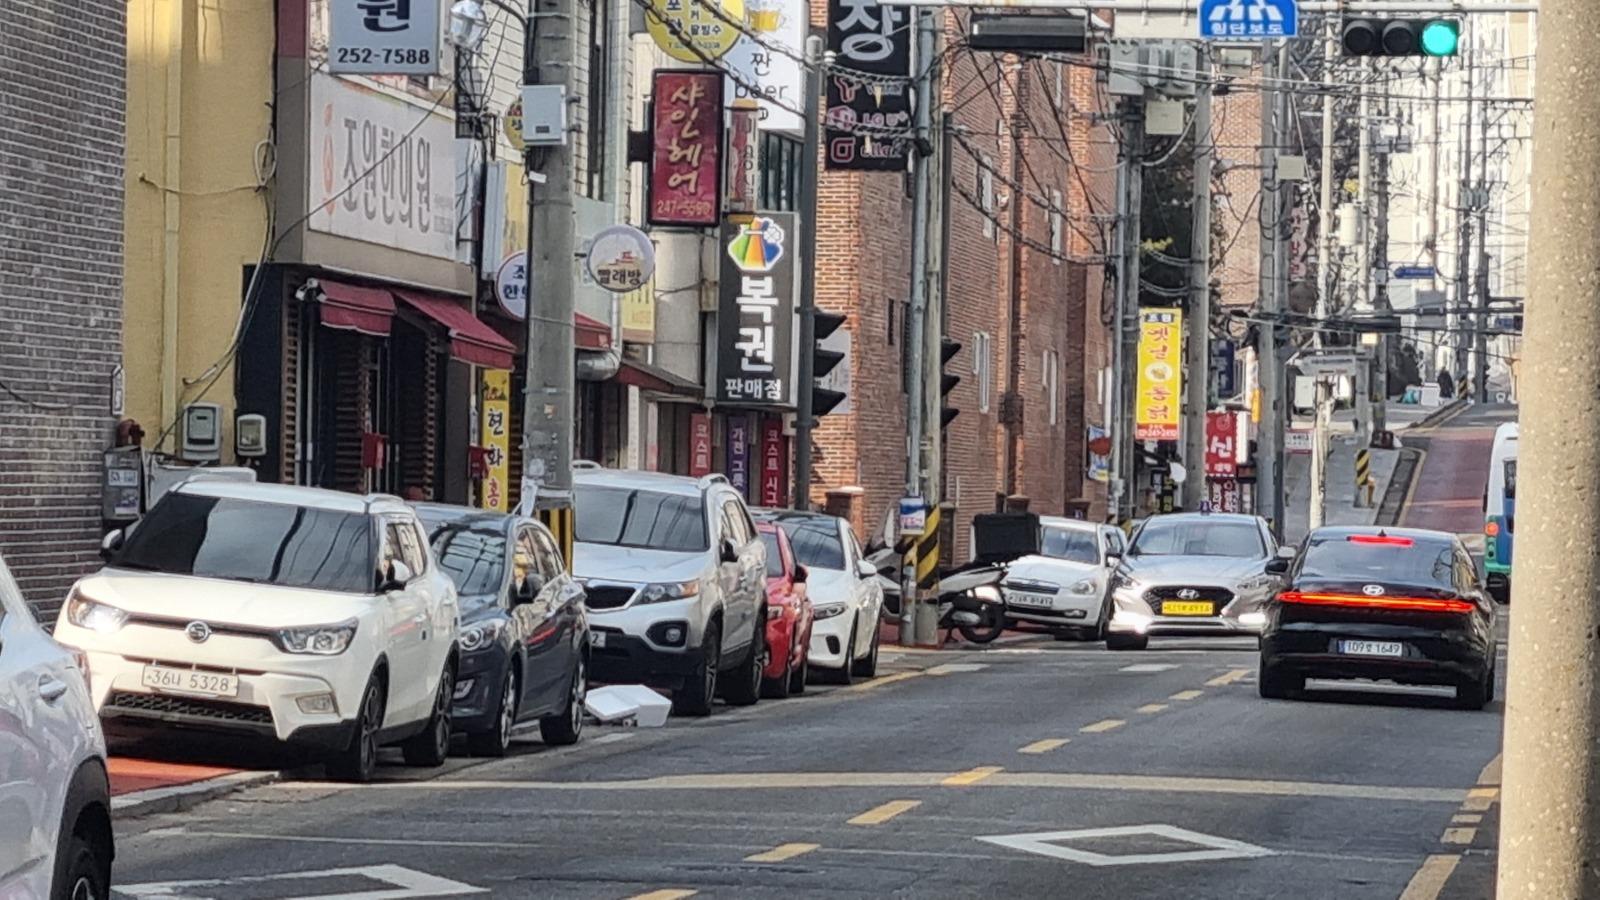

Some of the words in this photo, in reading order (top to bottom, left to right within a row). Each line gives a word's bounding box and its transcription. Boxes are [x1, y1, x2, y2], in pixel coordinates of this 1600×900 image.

[1211, 22, 1284, 35] 횡단보도
[338, 47, 430, 65] 252-7588
[750, 51, 772, 77] 짠
[735, 80, 789, 99] beer
[667, 76, 705, 195] 샤인헤어
[342, 117, 431, 234] 조원한의원
[735, 275, 779, 372] 복권
[725, 379, 781, 400] 판매점
[189, 674, 229, 692] 5328
